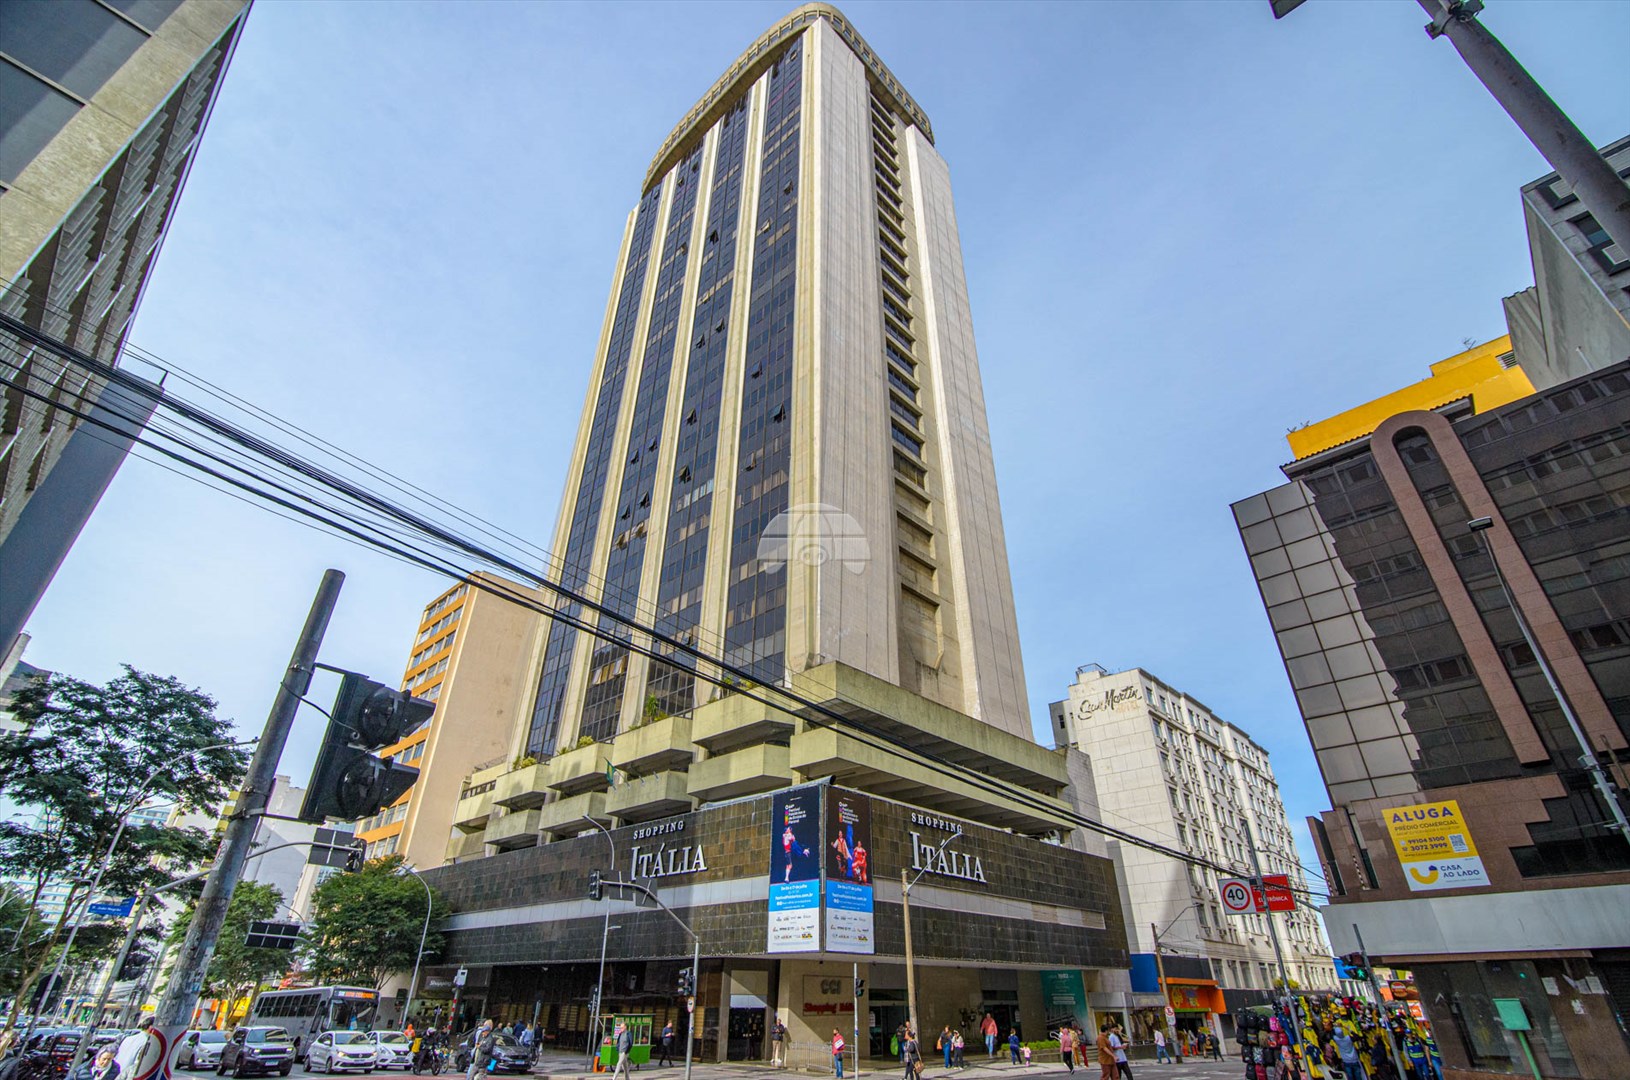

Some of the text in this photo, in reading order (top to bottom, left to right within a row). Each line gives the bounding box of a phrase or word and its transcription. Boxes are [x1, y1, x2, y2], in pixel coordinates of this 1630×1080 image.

[1104, 686, 1142, 710] Martin
[911, 812, 962, 834] SHOPPING
[1393, 806, 1453, 823] ALUGA
[633, 820, 684, 840] SHOPPING
[1420, 819, 1459, 829] COMERCIAL
[631, 842, 708, 880] ITÁLIA
[909, 831, 987, 883] ITÁLIA
[1440, 864, 1463, 872] CASA
[1457, 869, 1480, 877] LADO
[1227, 888, 1244, 900] 40
